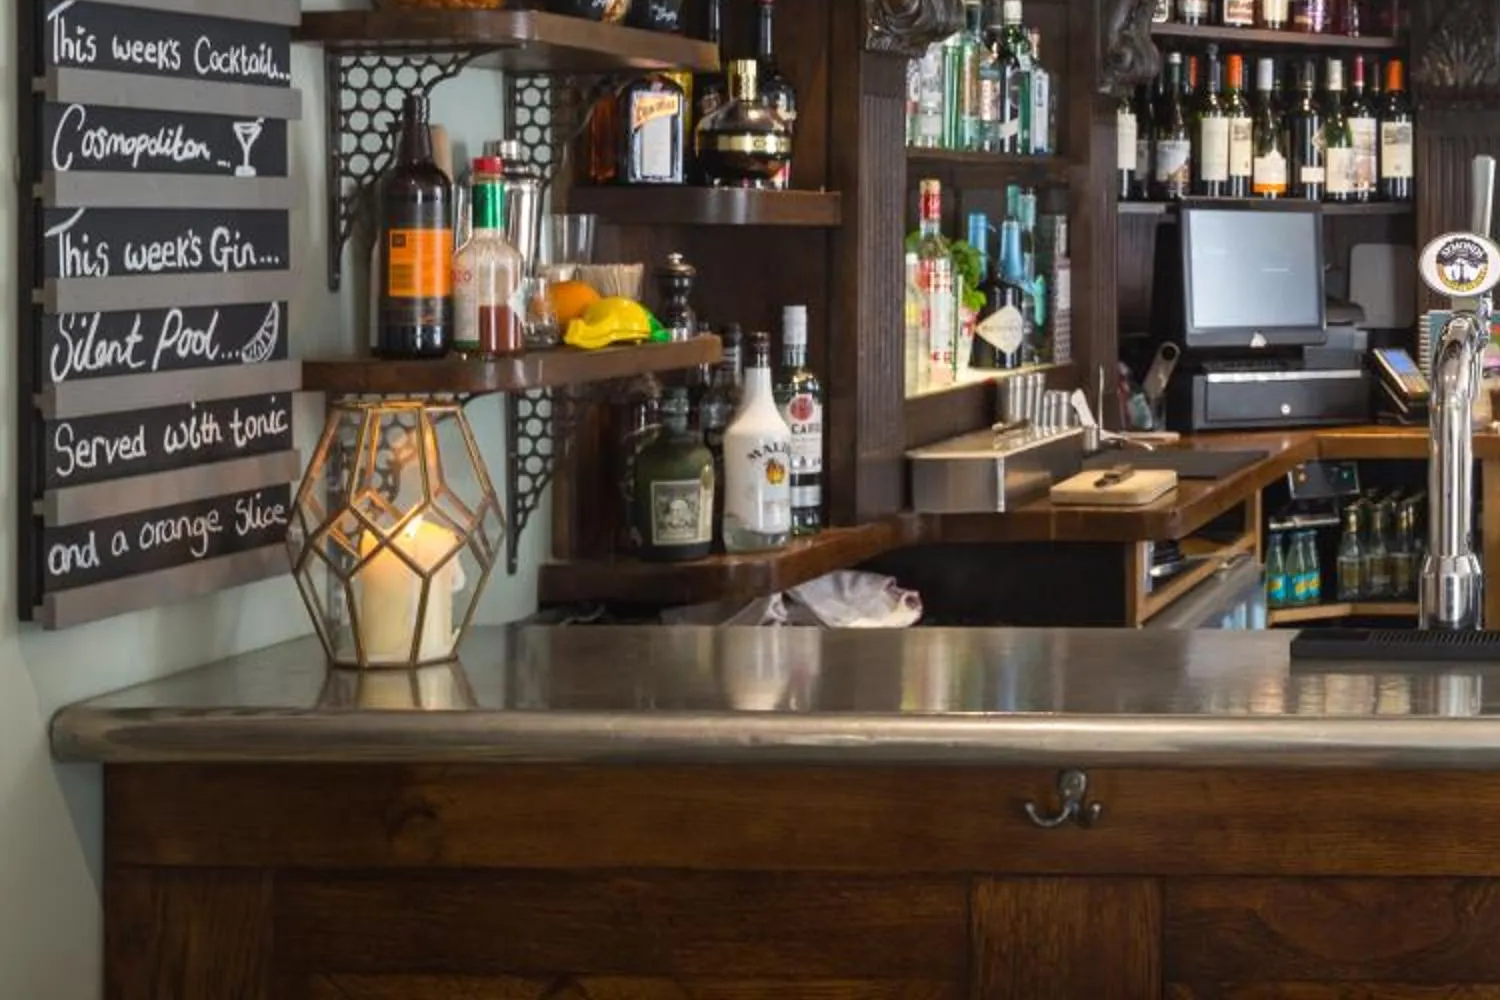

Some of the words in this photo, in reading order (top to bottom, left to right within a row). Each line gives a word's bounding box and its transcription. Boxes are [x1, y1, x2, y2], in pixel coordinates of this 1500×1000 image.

[47, 0, 97, 64] This
[44, 206, 110, 279] This
[123, 228, 203, 272] week's
[51, 311, 146, 384] Silent
[54, 422, 147, 478] Served
[163, 400, 223, 455] with
[230, 395, 289, 449] tonic
[48, 530, 100, 576] and
[111, 530, 130, 557] a
[139, 509, 223, 558] orange
